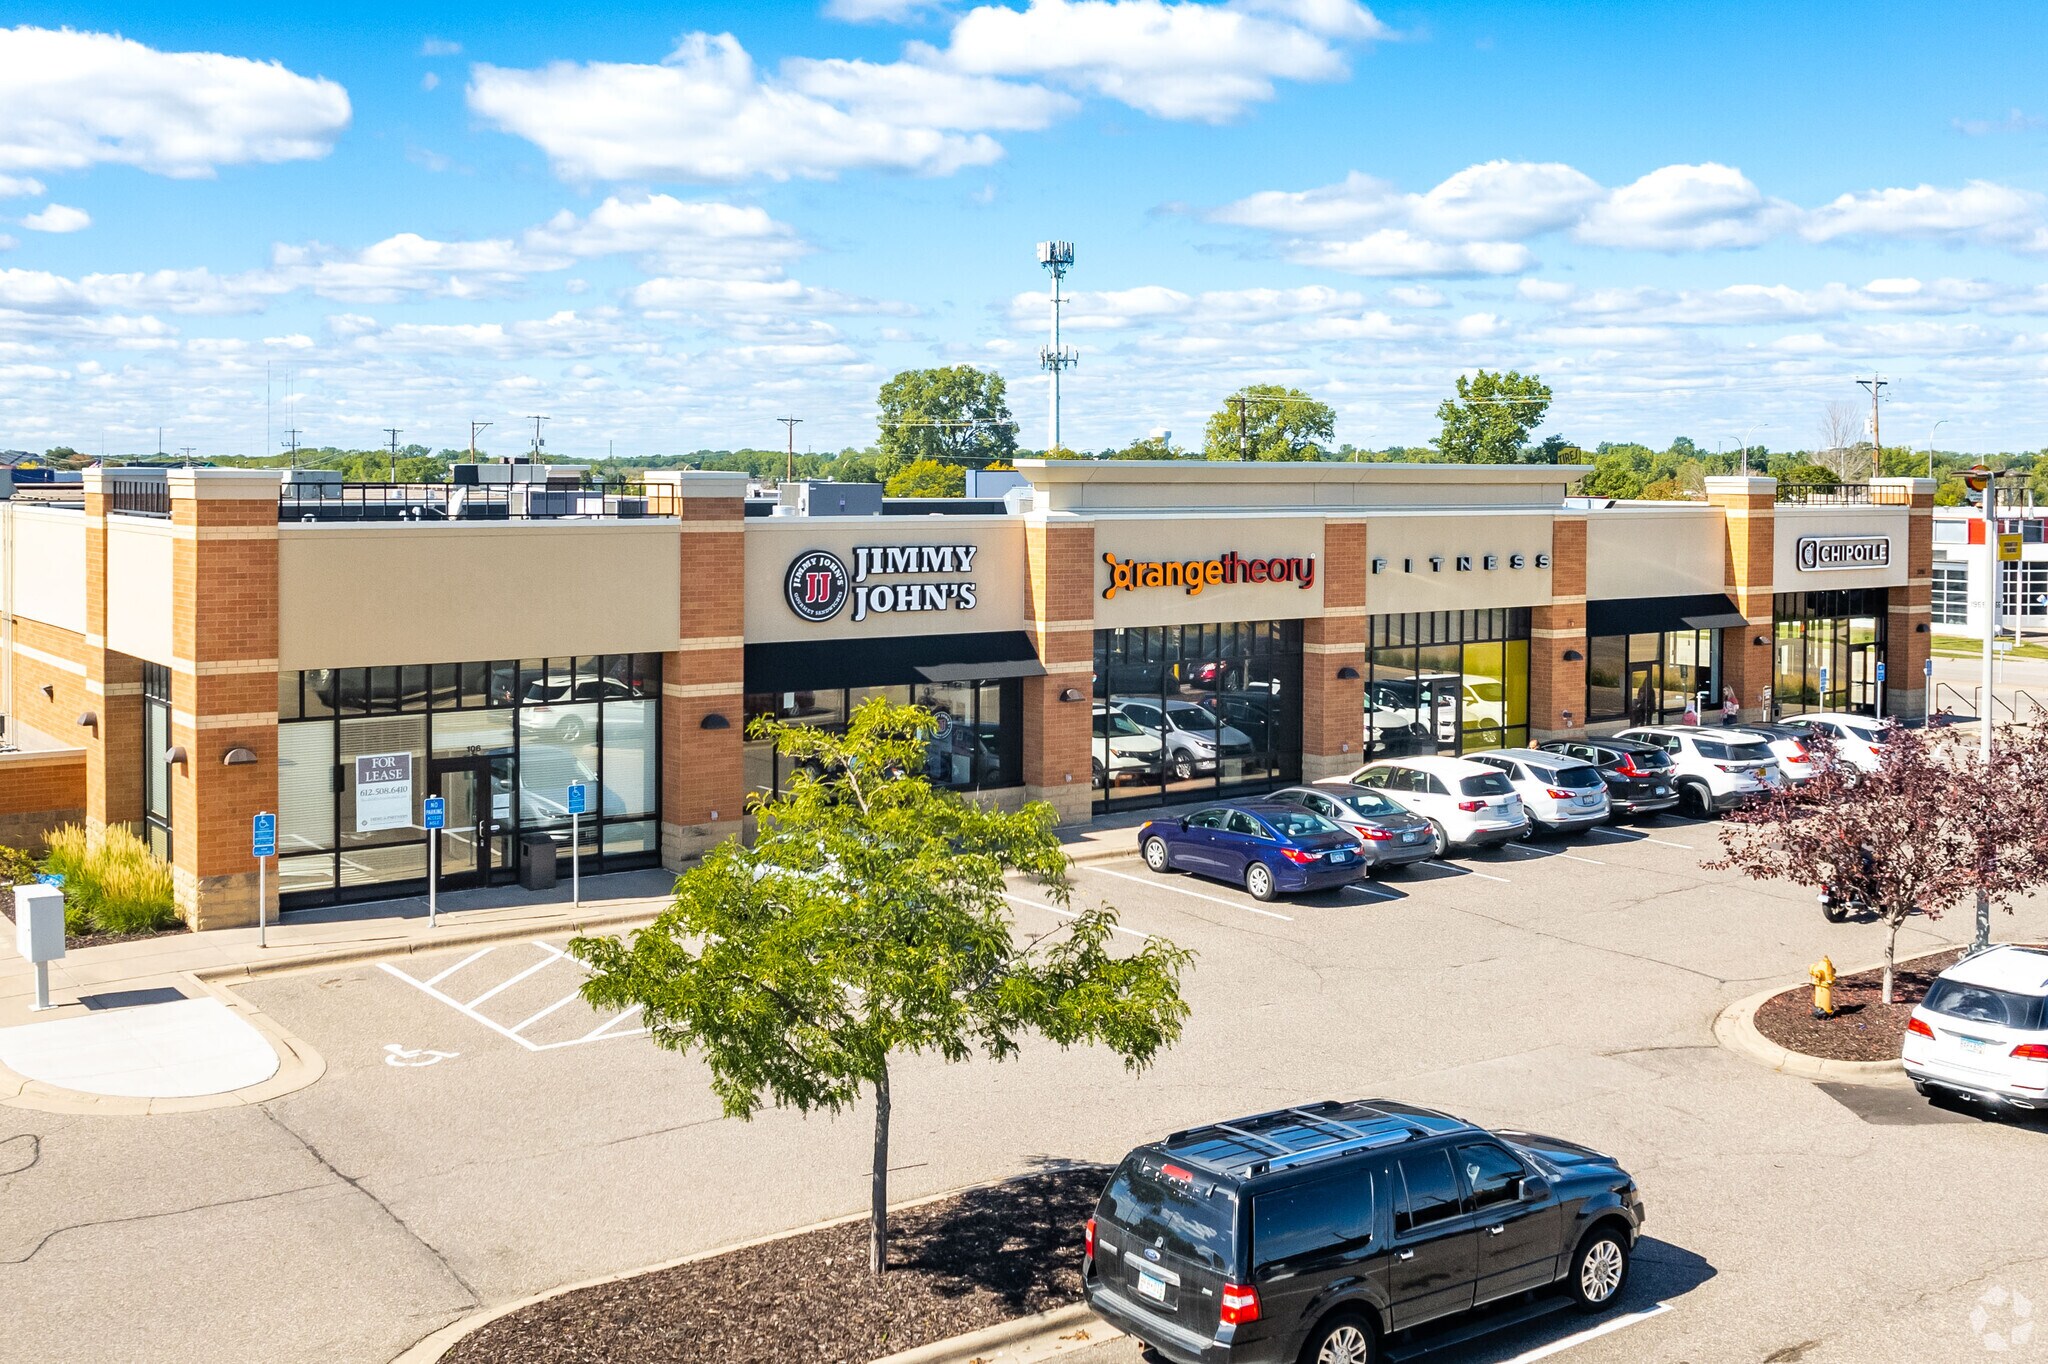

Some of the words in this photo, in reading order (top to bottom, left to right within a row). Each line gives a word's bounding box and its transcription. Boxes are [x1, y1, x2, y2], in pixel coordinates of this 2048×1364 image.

[854, 546, 977, 583] JIMMY
[1372, 553, 1550, 575] FITNESS
[1820, 544, 1887, 562] CHIPOTLE
[793, 557, 817, 587] JIMMY
[819, 557, 844, 586] JOHN'S
[1102, 551, 1315, 600] orangetheory
[805, 572, 832, 603] JJ
[854, 583, 977, 622] JOHN'S
[365, 768, 404, 782] LEASE
[371, 756, 396, 769] FOR
[360, 785, 408, 797] 612.508.6410
